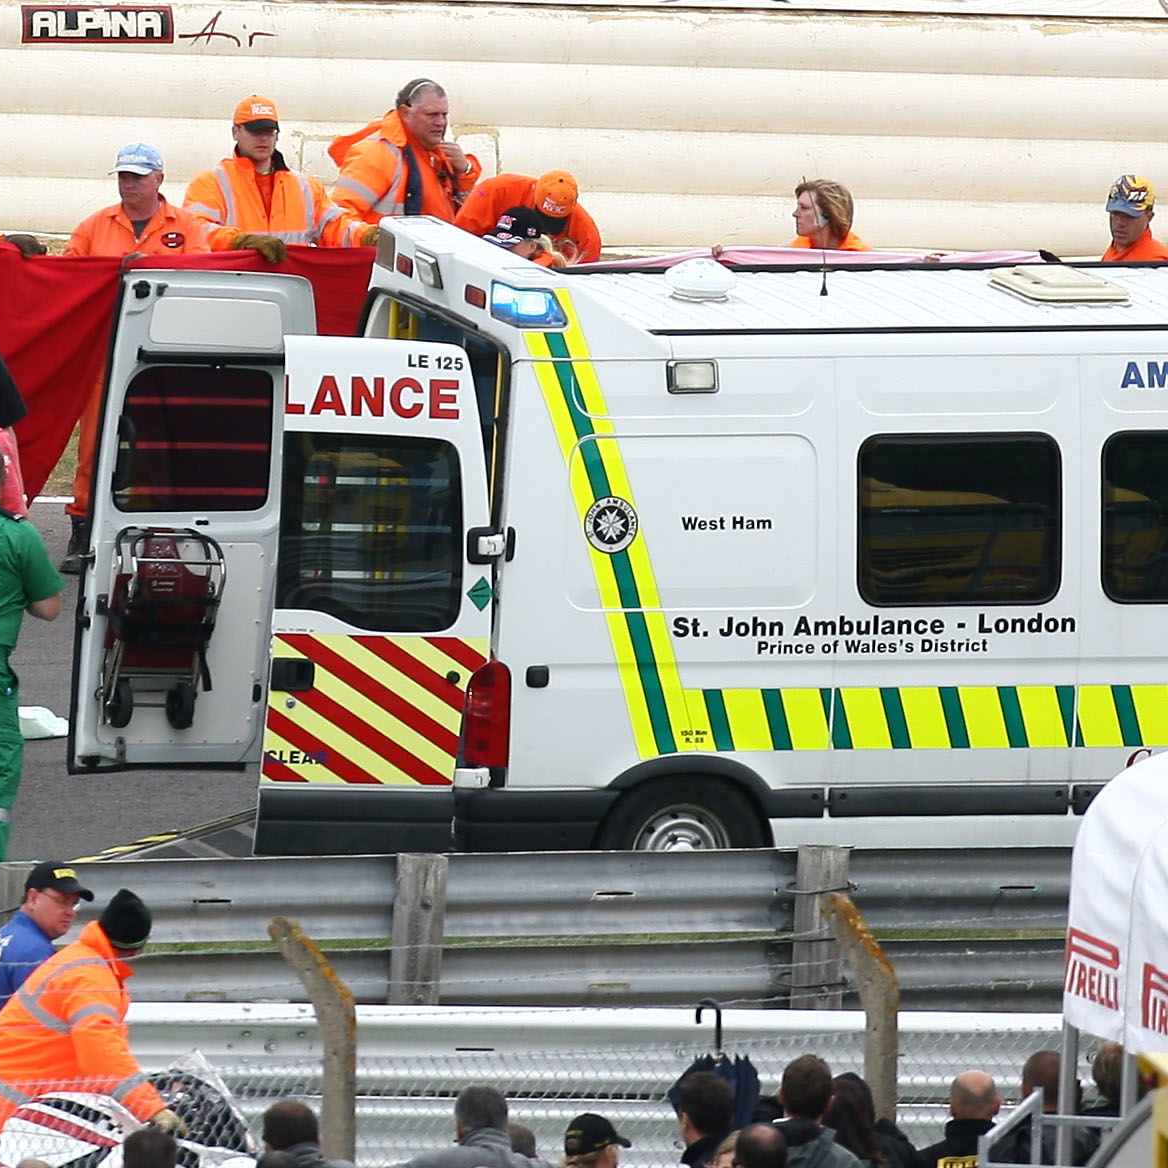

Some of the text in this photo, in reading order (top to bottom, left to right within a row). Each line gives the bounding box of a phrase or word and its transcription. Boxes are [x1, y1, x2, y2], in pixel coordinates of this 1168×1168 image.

[32, 11, 162, 38] ALPINA
[407, 353, 464, 371] LE 125
[681, 515, 772, 531] West Ham
[673, 617, 709, 638] St.
[719, 616, 784, 637] John
[793, 614, 945, 637] Ambulance
[978, 612, 1076, 634] London
[757, 638, 988, 655] Prince of Wales's District
[1065, 926, 1120, 1012] PIRELLI
